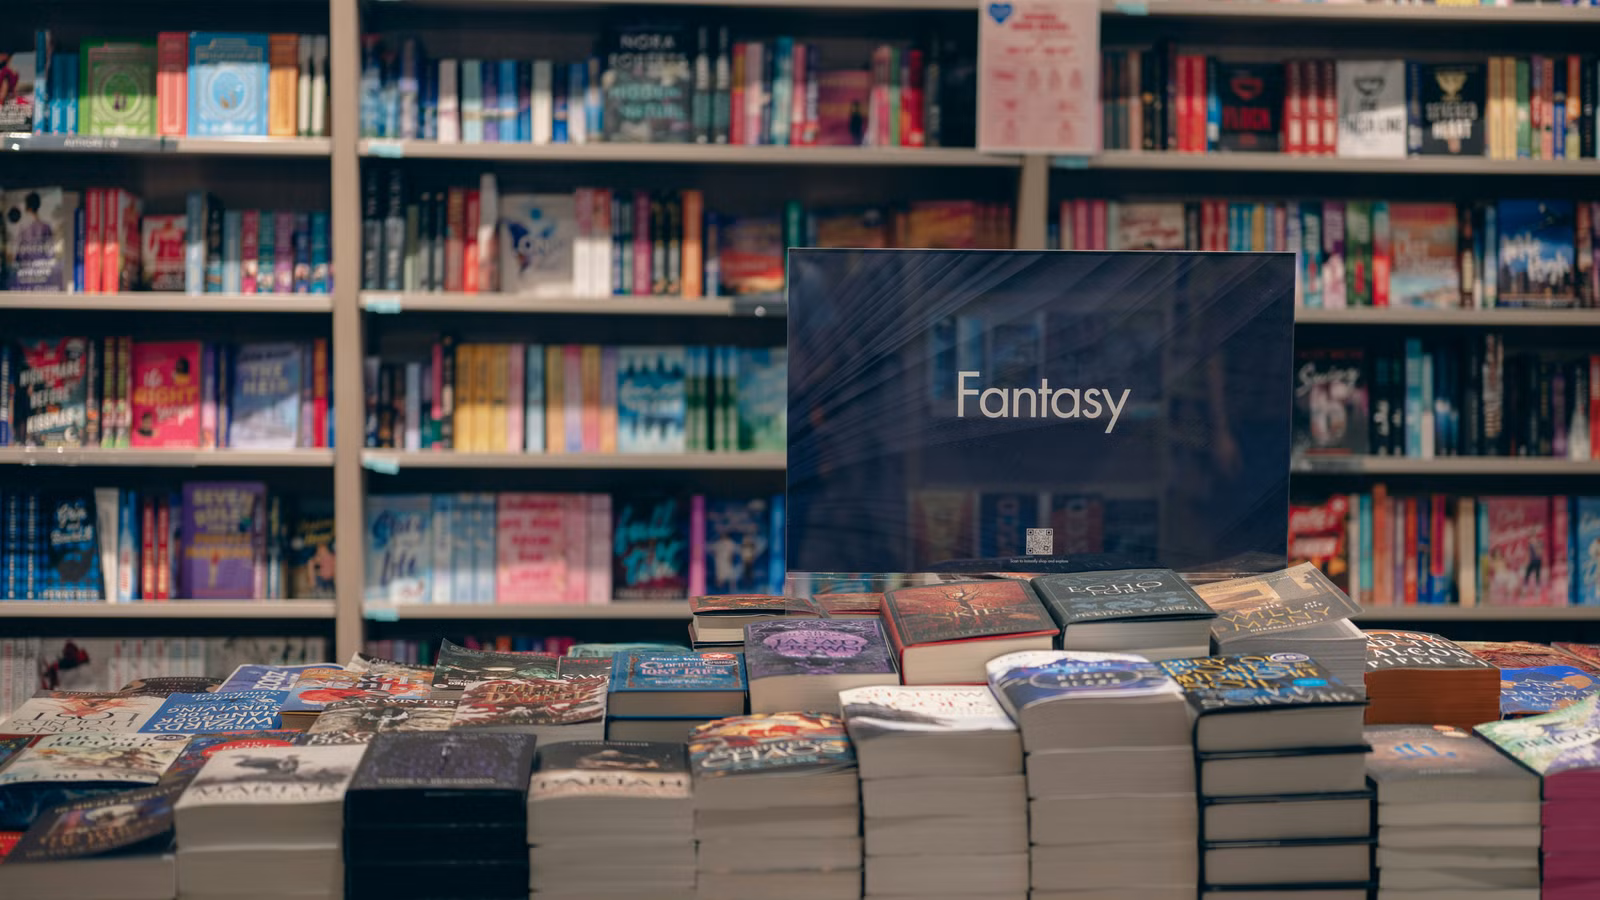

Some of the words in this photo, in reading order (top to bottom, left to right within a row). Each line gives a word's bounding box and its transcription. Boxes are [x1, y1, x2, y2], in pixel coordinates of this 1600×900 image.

[957, 371, 1131, 434] Fantasy
[1068, 581, 1162, 593] ECHO
[1222, 606, 1302, 622] WILL
[1233, 606, 1330, 631] MANY
[1388, 632, 1446, 640] FOX
[1366, 639, 1397, 647] ND
[1373, 647, 1475, 658] ALCON
[1367, 657, 1446, 668] PIPER
[167, 704, 281, 713] SURVIVING
[33, 711, 139, 722] LOST
[158, 711, 278, 724] HANDBOOK
[149, 717, 274, 731] WIZARD'S
